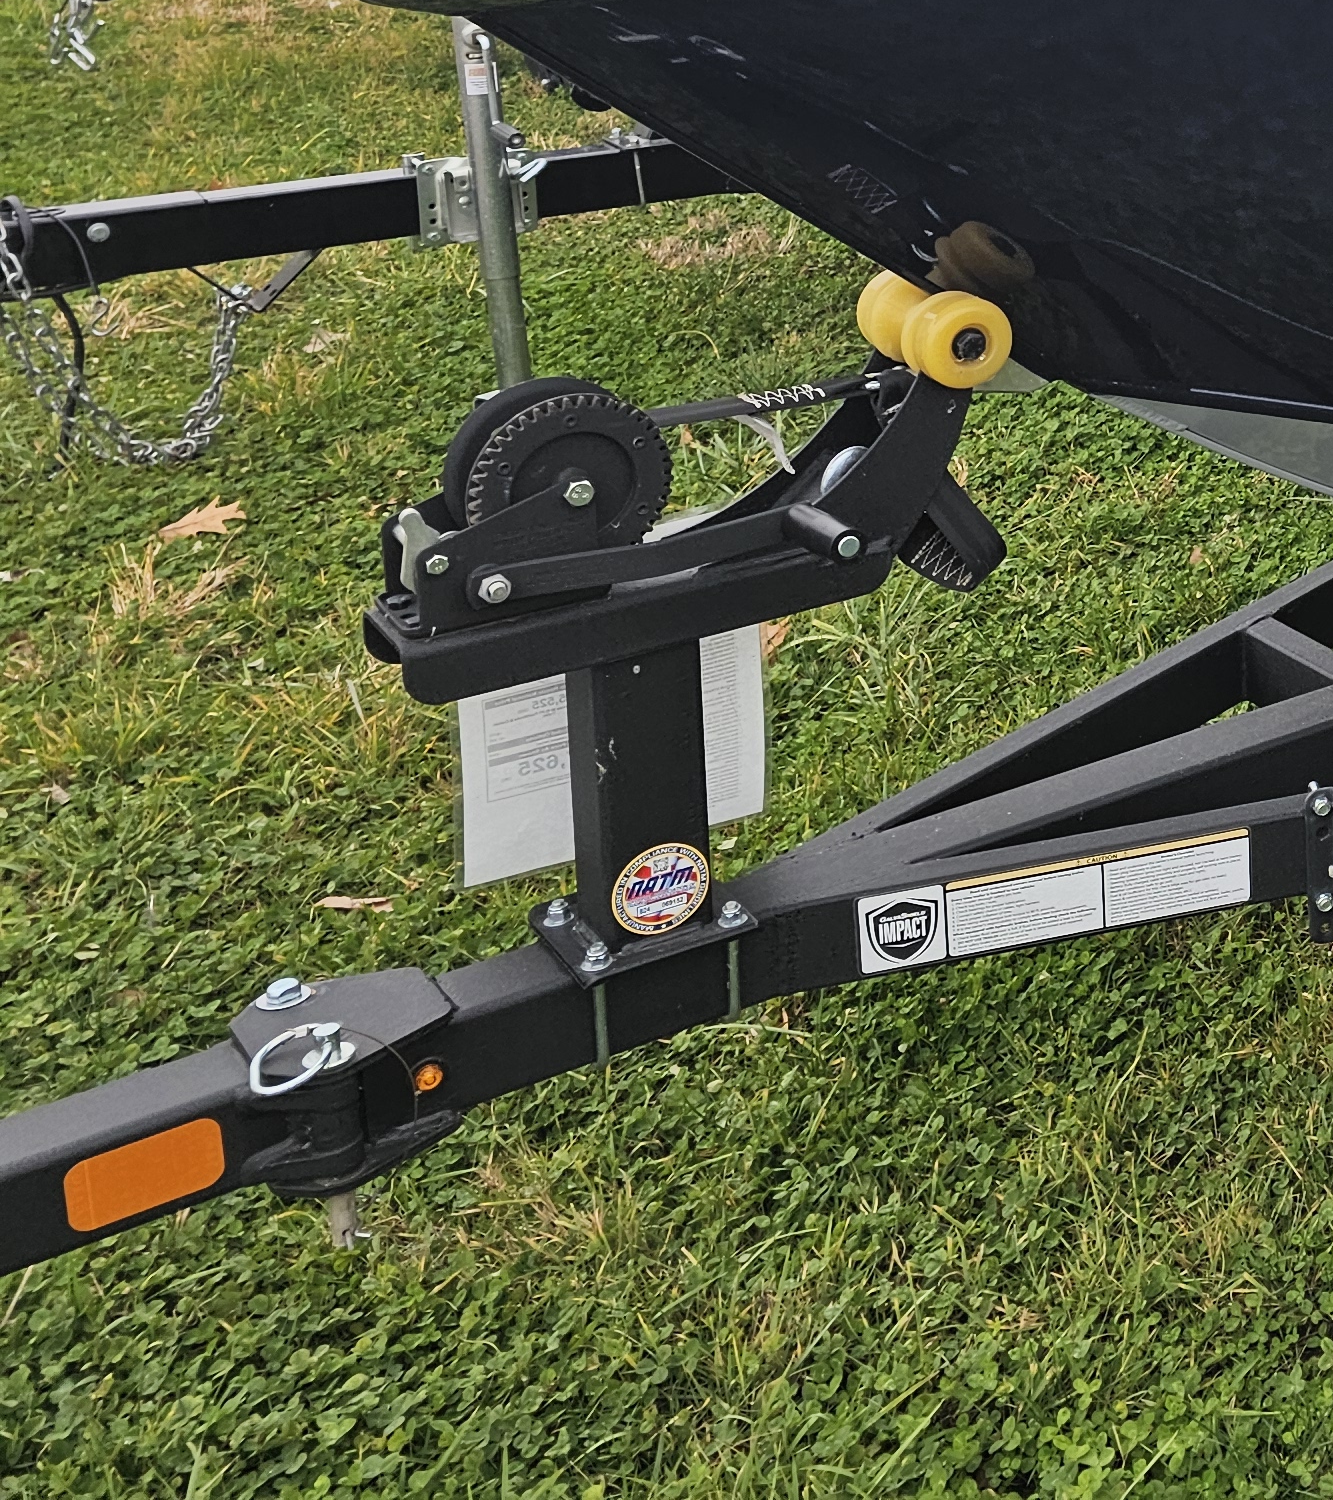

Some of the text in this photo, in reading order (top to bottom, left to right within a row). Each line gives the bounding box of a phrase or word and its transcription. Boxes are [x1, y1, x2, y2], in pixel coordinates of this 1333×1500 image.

[626, 847, 678, 876] COMPLIANCE
[679, 847, 699, 861] WITH
[1086, 853, 1118, 863] CAUTION
[878, 915, 928, 945] IMPACT
